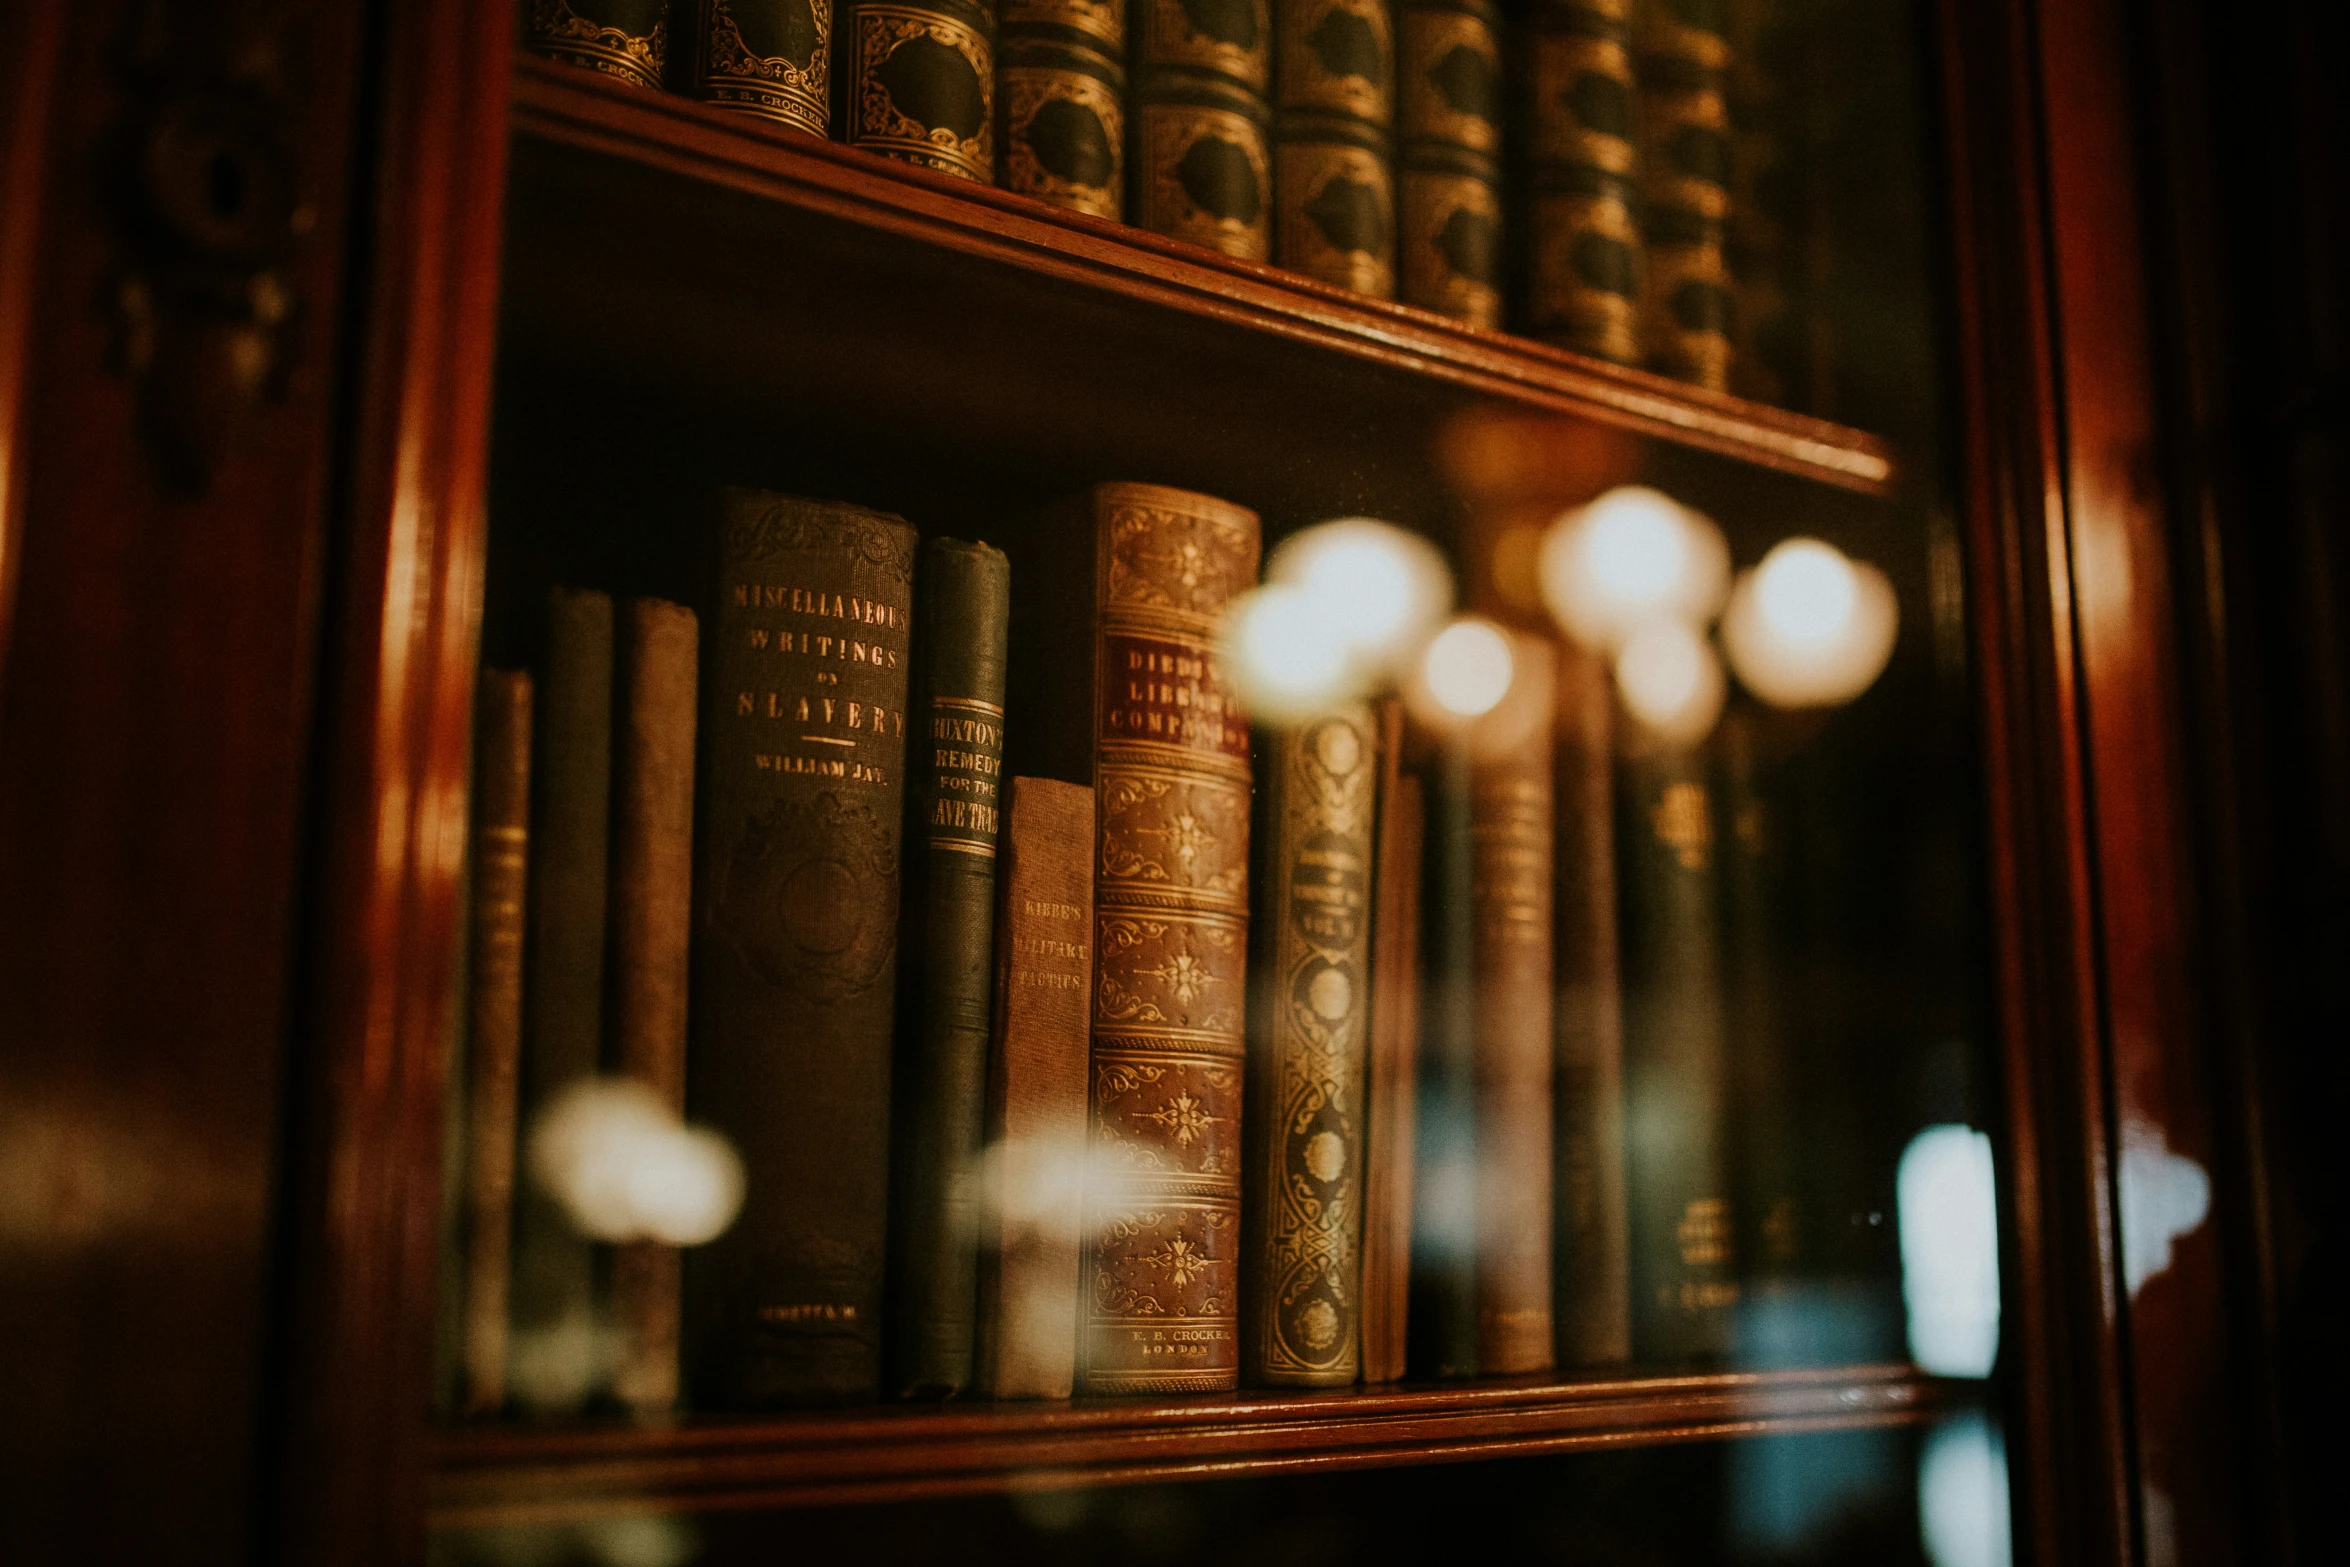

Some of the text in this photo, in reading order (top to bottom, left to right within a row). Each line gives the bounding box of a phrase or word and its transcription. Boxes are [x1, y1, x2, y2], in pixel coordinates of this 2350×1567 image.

[597, 61, 651, 87] CROCK
[717, 90, 825, 129] E. B. CROCKER.
[733, 583, 907, 632] MISCELLANEOUS
[750, 628, 897, 670] WRITINGS
[736, 691, 904, 738] SLAVERY
[754, 753, 846, 778] WILLIAM
[935, 749, 1001, 777] REMEDY
[940, 775, 996, 797] FOR THE
[931, 798, 965, 827] AVE
[1132, 1331, 1146, 1341] E.
[1154, 1331, 1167, 1341] B.
[1142, 1345, 1209, 1356] LONDON
